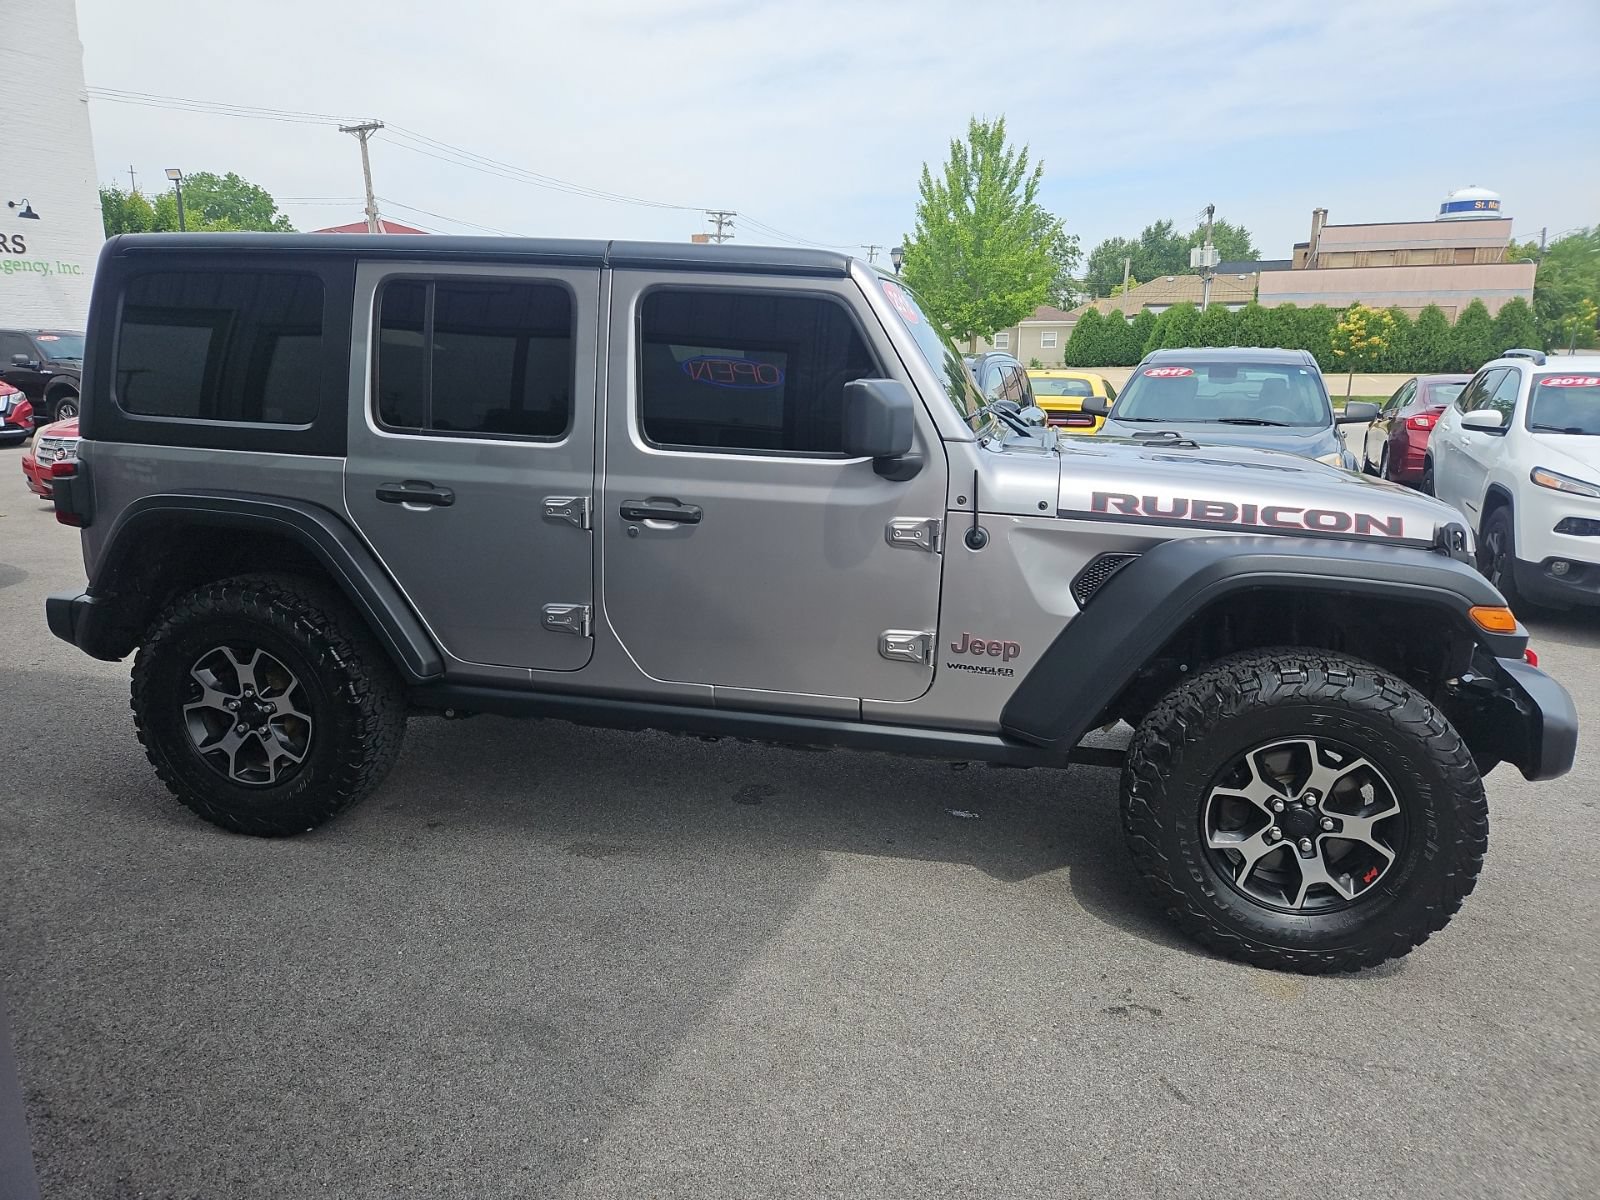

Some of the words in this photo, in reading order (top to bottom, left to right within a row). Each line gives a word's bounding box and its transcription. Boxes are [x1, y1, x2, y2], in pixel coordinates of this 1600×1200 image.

[0, 260, 53, 277] gency,
[56, 261, 84, 275] Inc.
[1149, 367, 1190, 377] 2017
[1549, 377, 1598, 386] 2018
[1091, 491, 1404, 537] RUBICON
[951, 632, 1021, 662] Jeep
[946, 662, 1014, 674] WRANGLER
